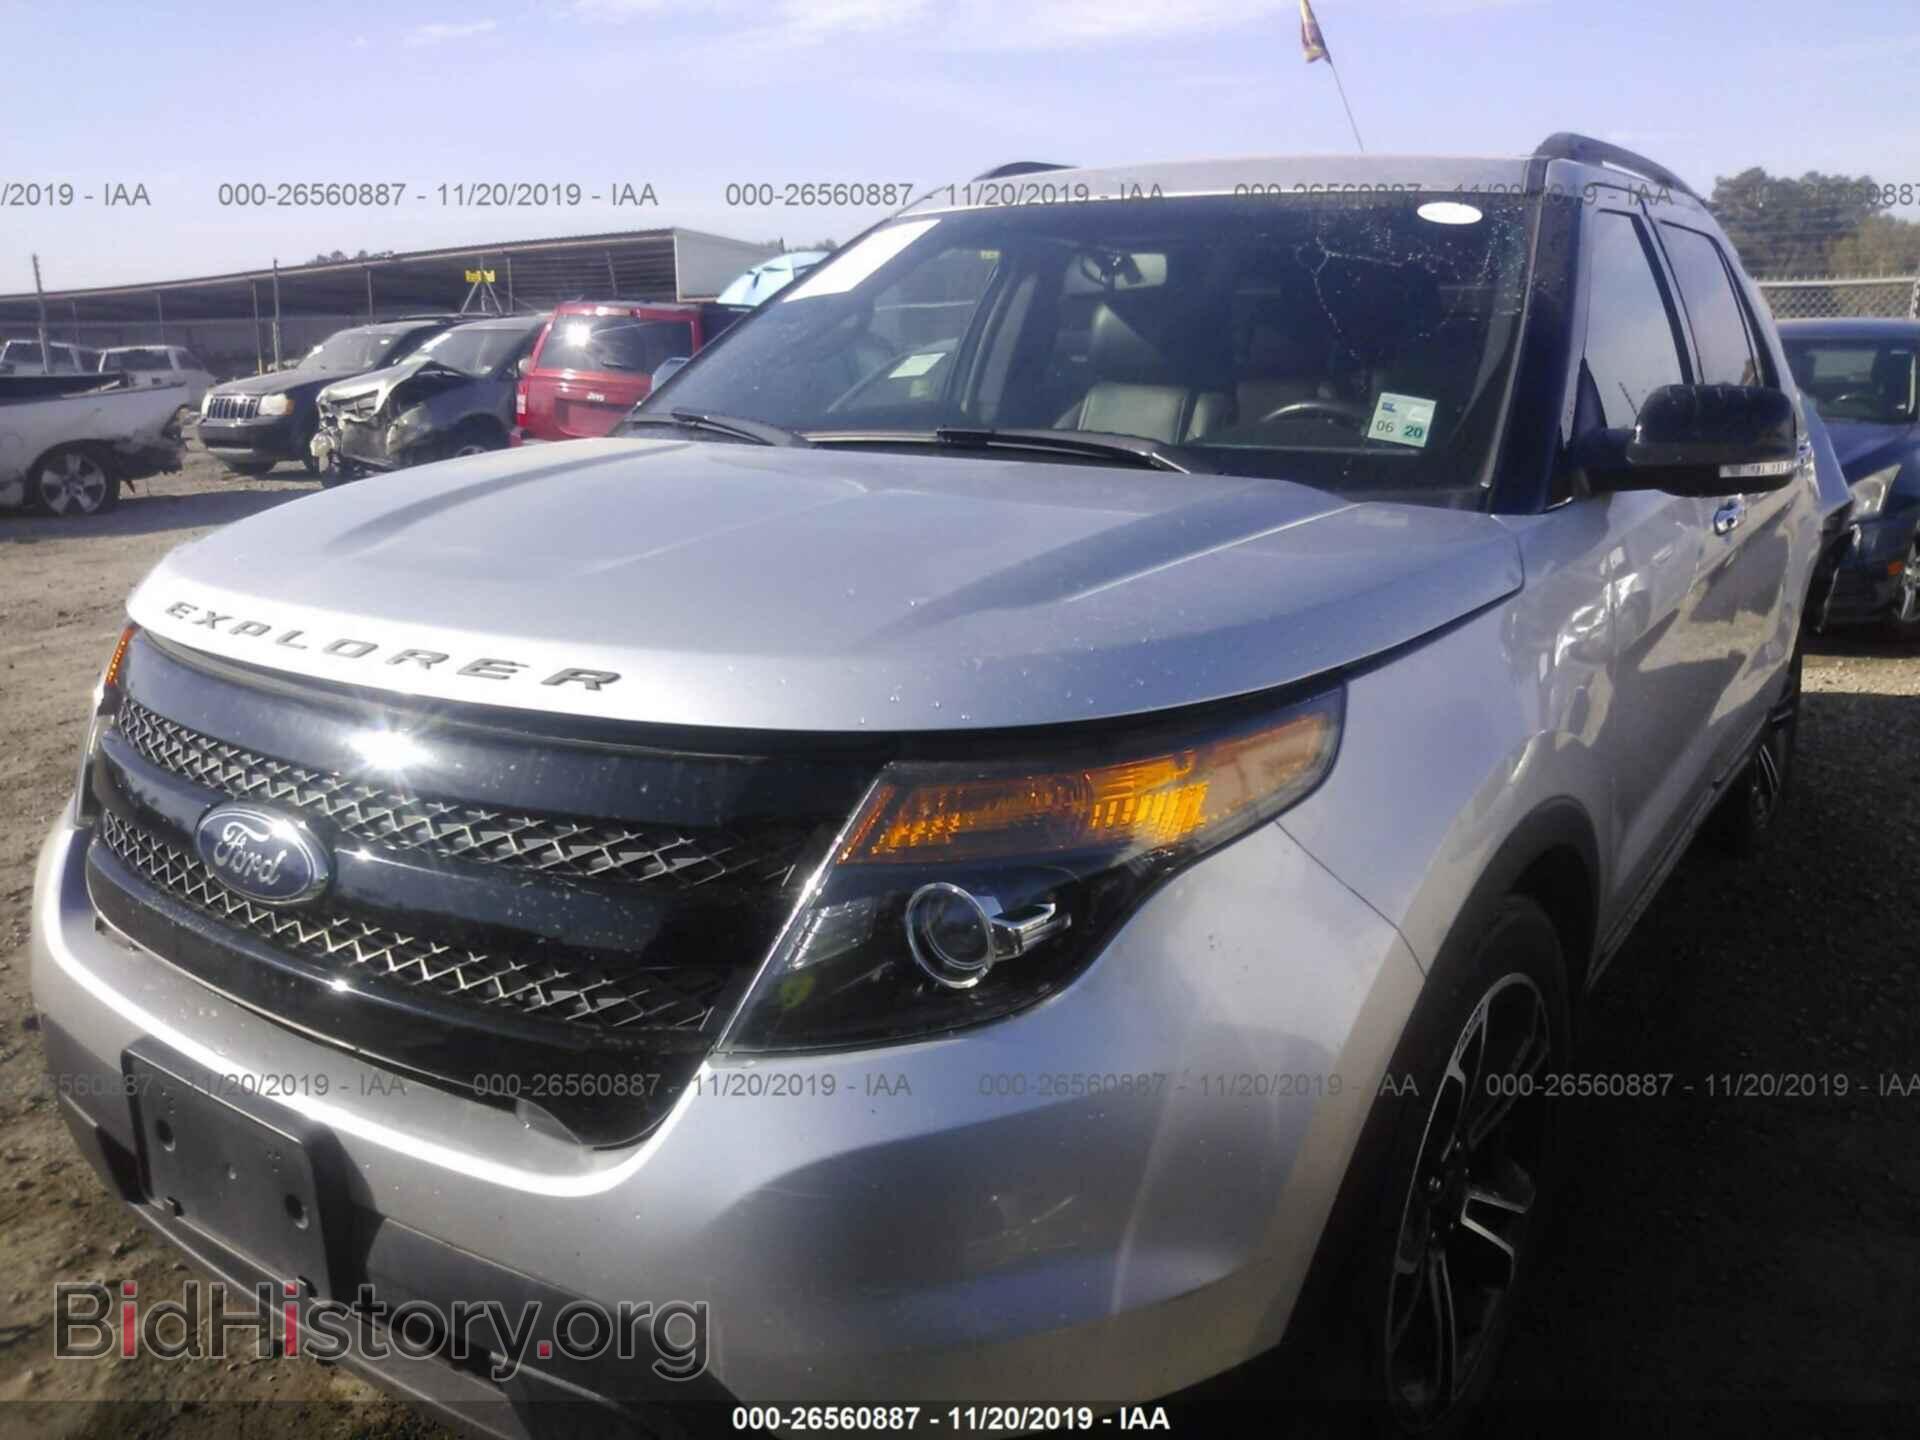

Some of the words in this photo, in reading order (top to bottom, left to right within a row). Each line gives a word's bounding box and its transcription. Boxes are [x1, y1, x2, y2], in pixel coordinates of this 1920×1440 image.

[1376, 420, 1394, 433] 06
[1403, 424, 1424, 439] 20
[164, 600, 623, 692] EXPLORER
[214, 821, 288, 886] Ford
